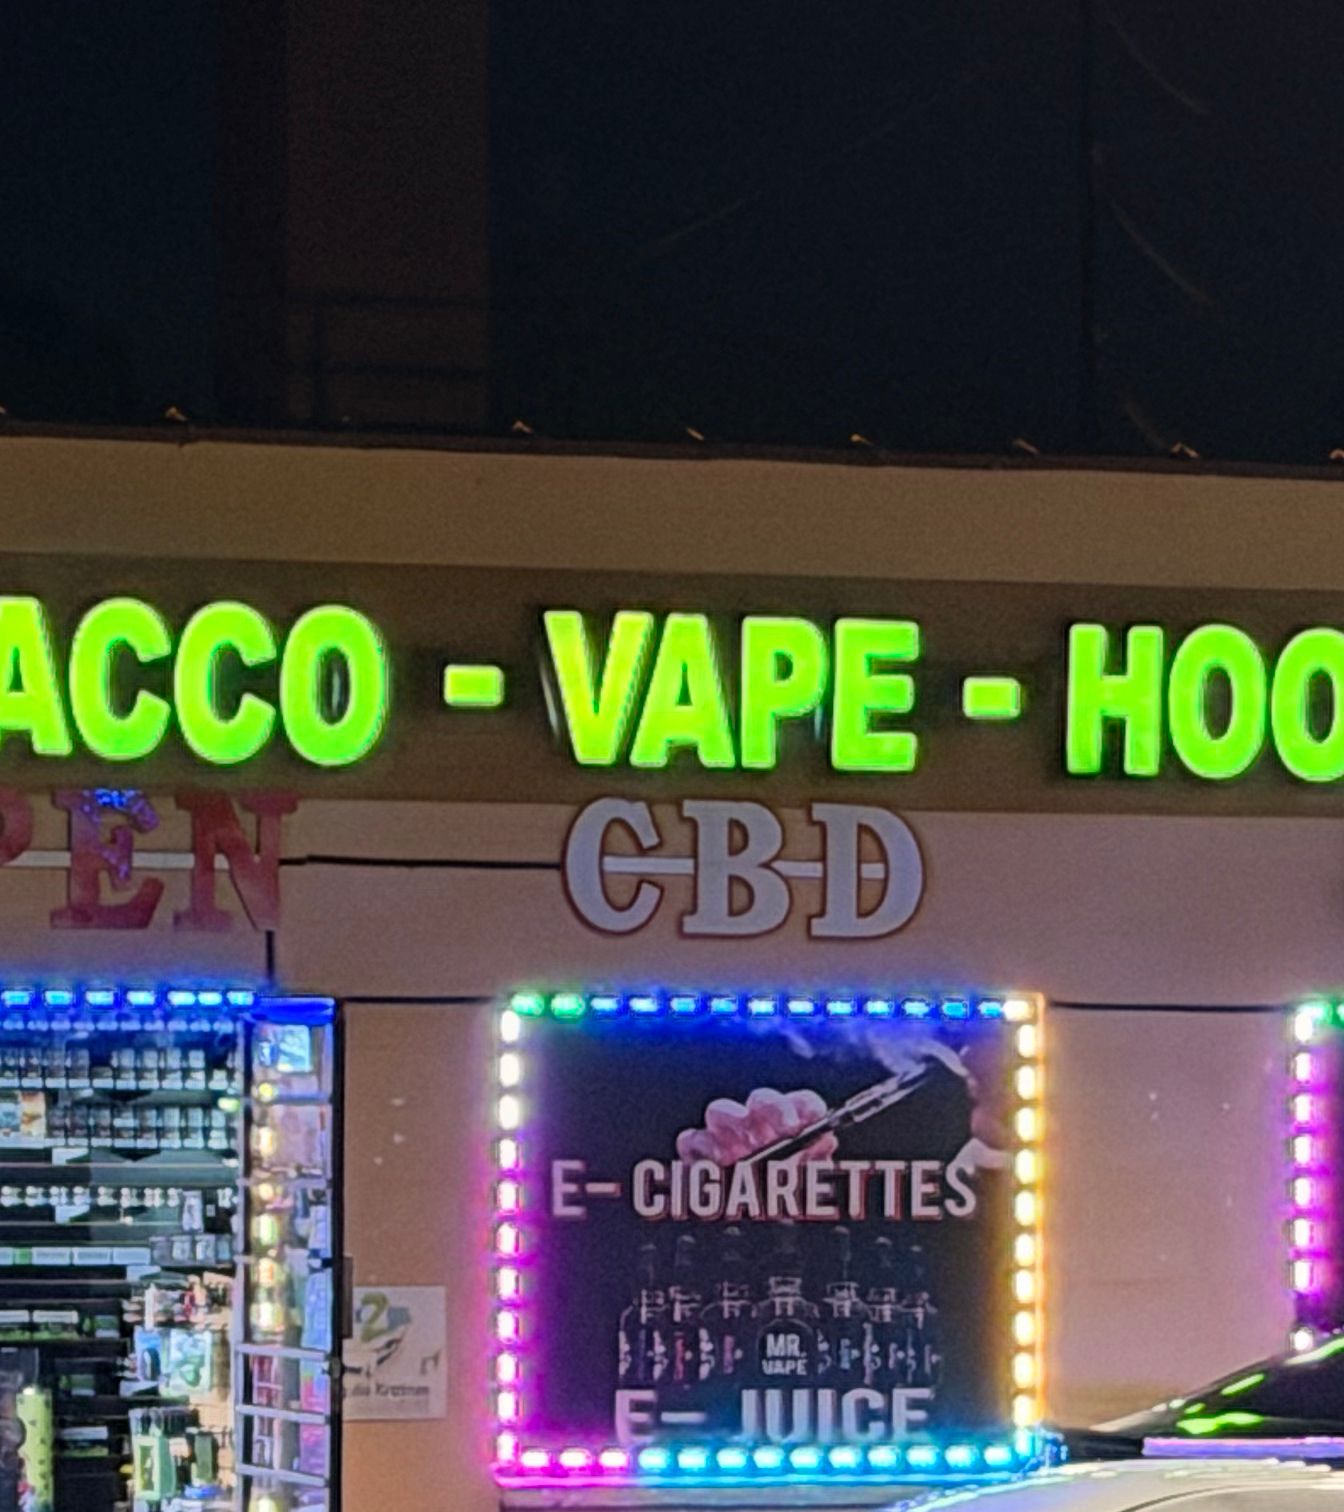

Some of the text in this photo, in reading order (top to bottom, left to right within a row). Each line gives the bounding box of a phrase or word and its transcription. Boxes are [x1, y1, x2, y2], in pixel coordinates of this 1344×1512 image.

[544, 611, 918, 770] VAPE
[562, 797, 924, 938] CBD
[766, 1333, 808, 1358] MR.
[730, 1388, 934, 1444] JUICE
